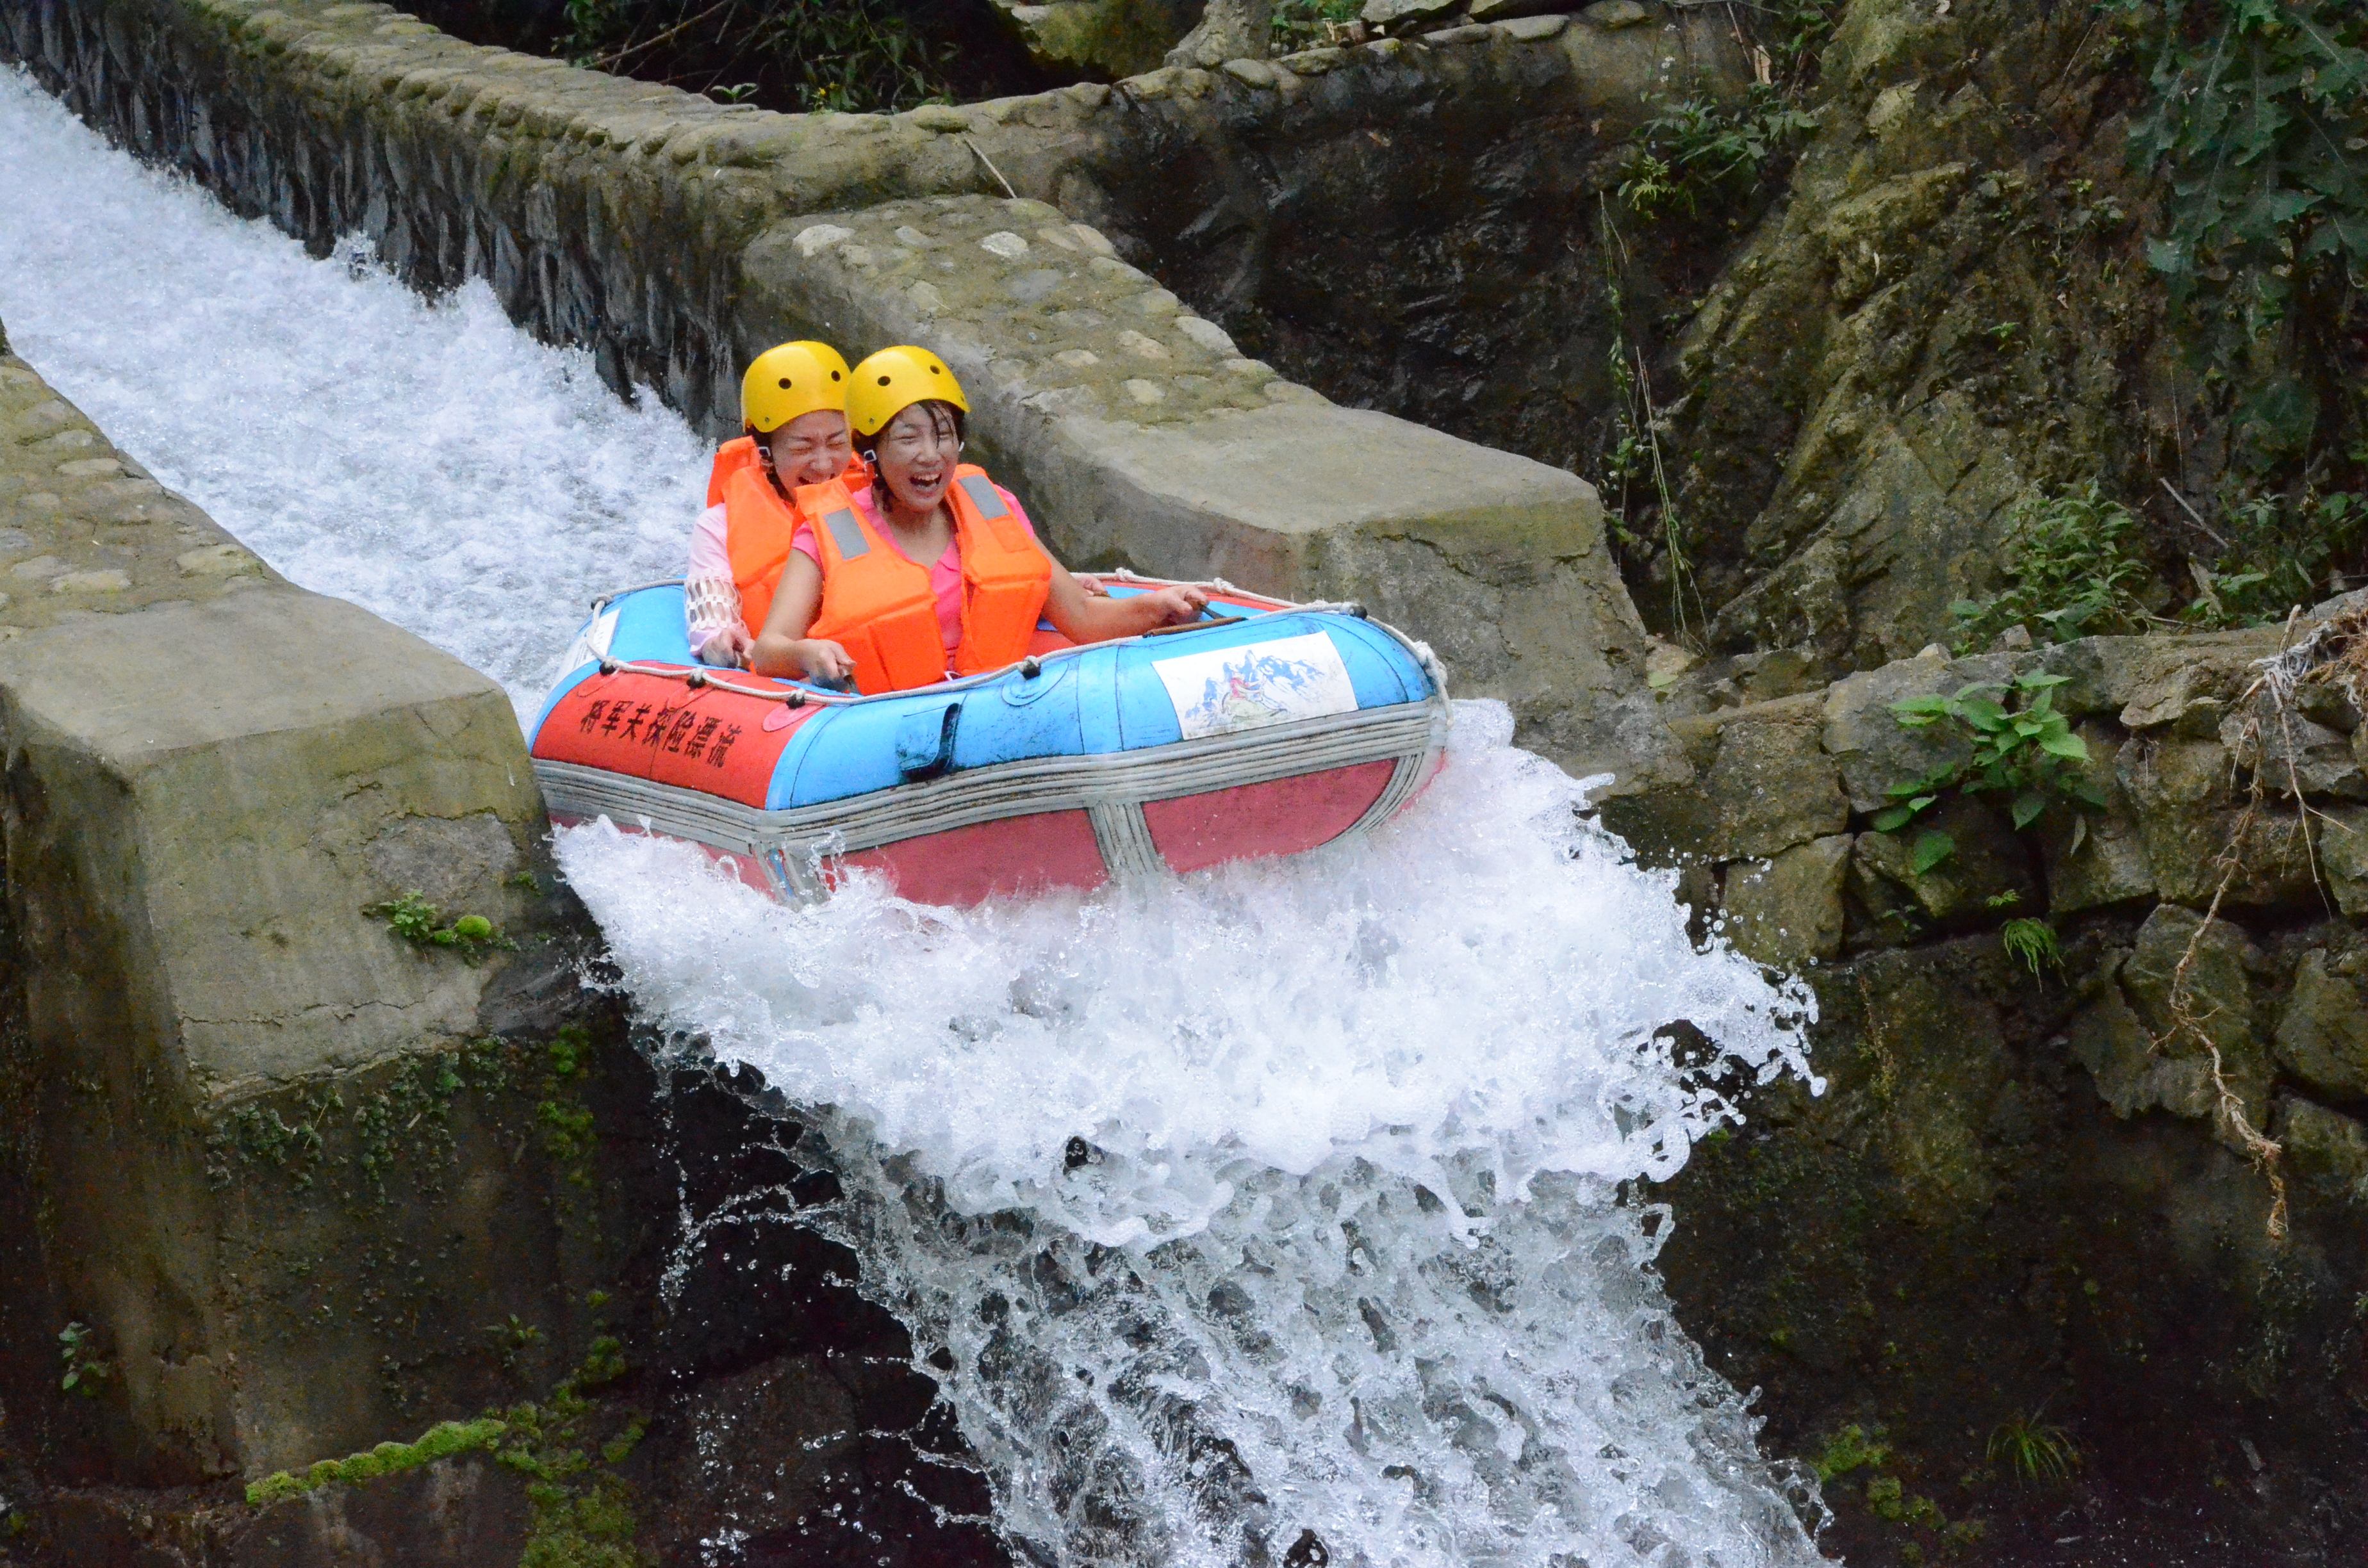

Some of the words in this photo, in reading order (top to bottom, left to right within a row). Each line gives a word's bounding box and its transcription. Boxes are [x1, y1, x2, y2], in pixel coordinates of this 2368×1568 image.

[580, 699, 742, 767] 将军关探险漂流
